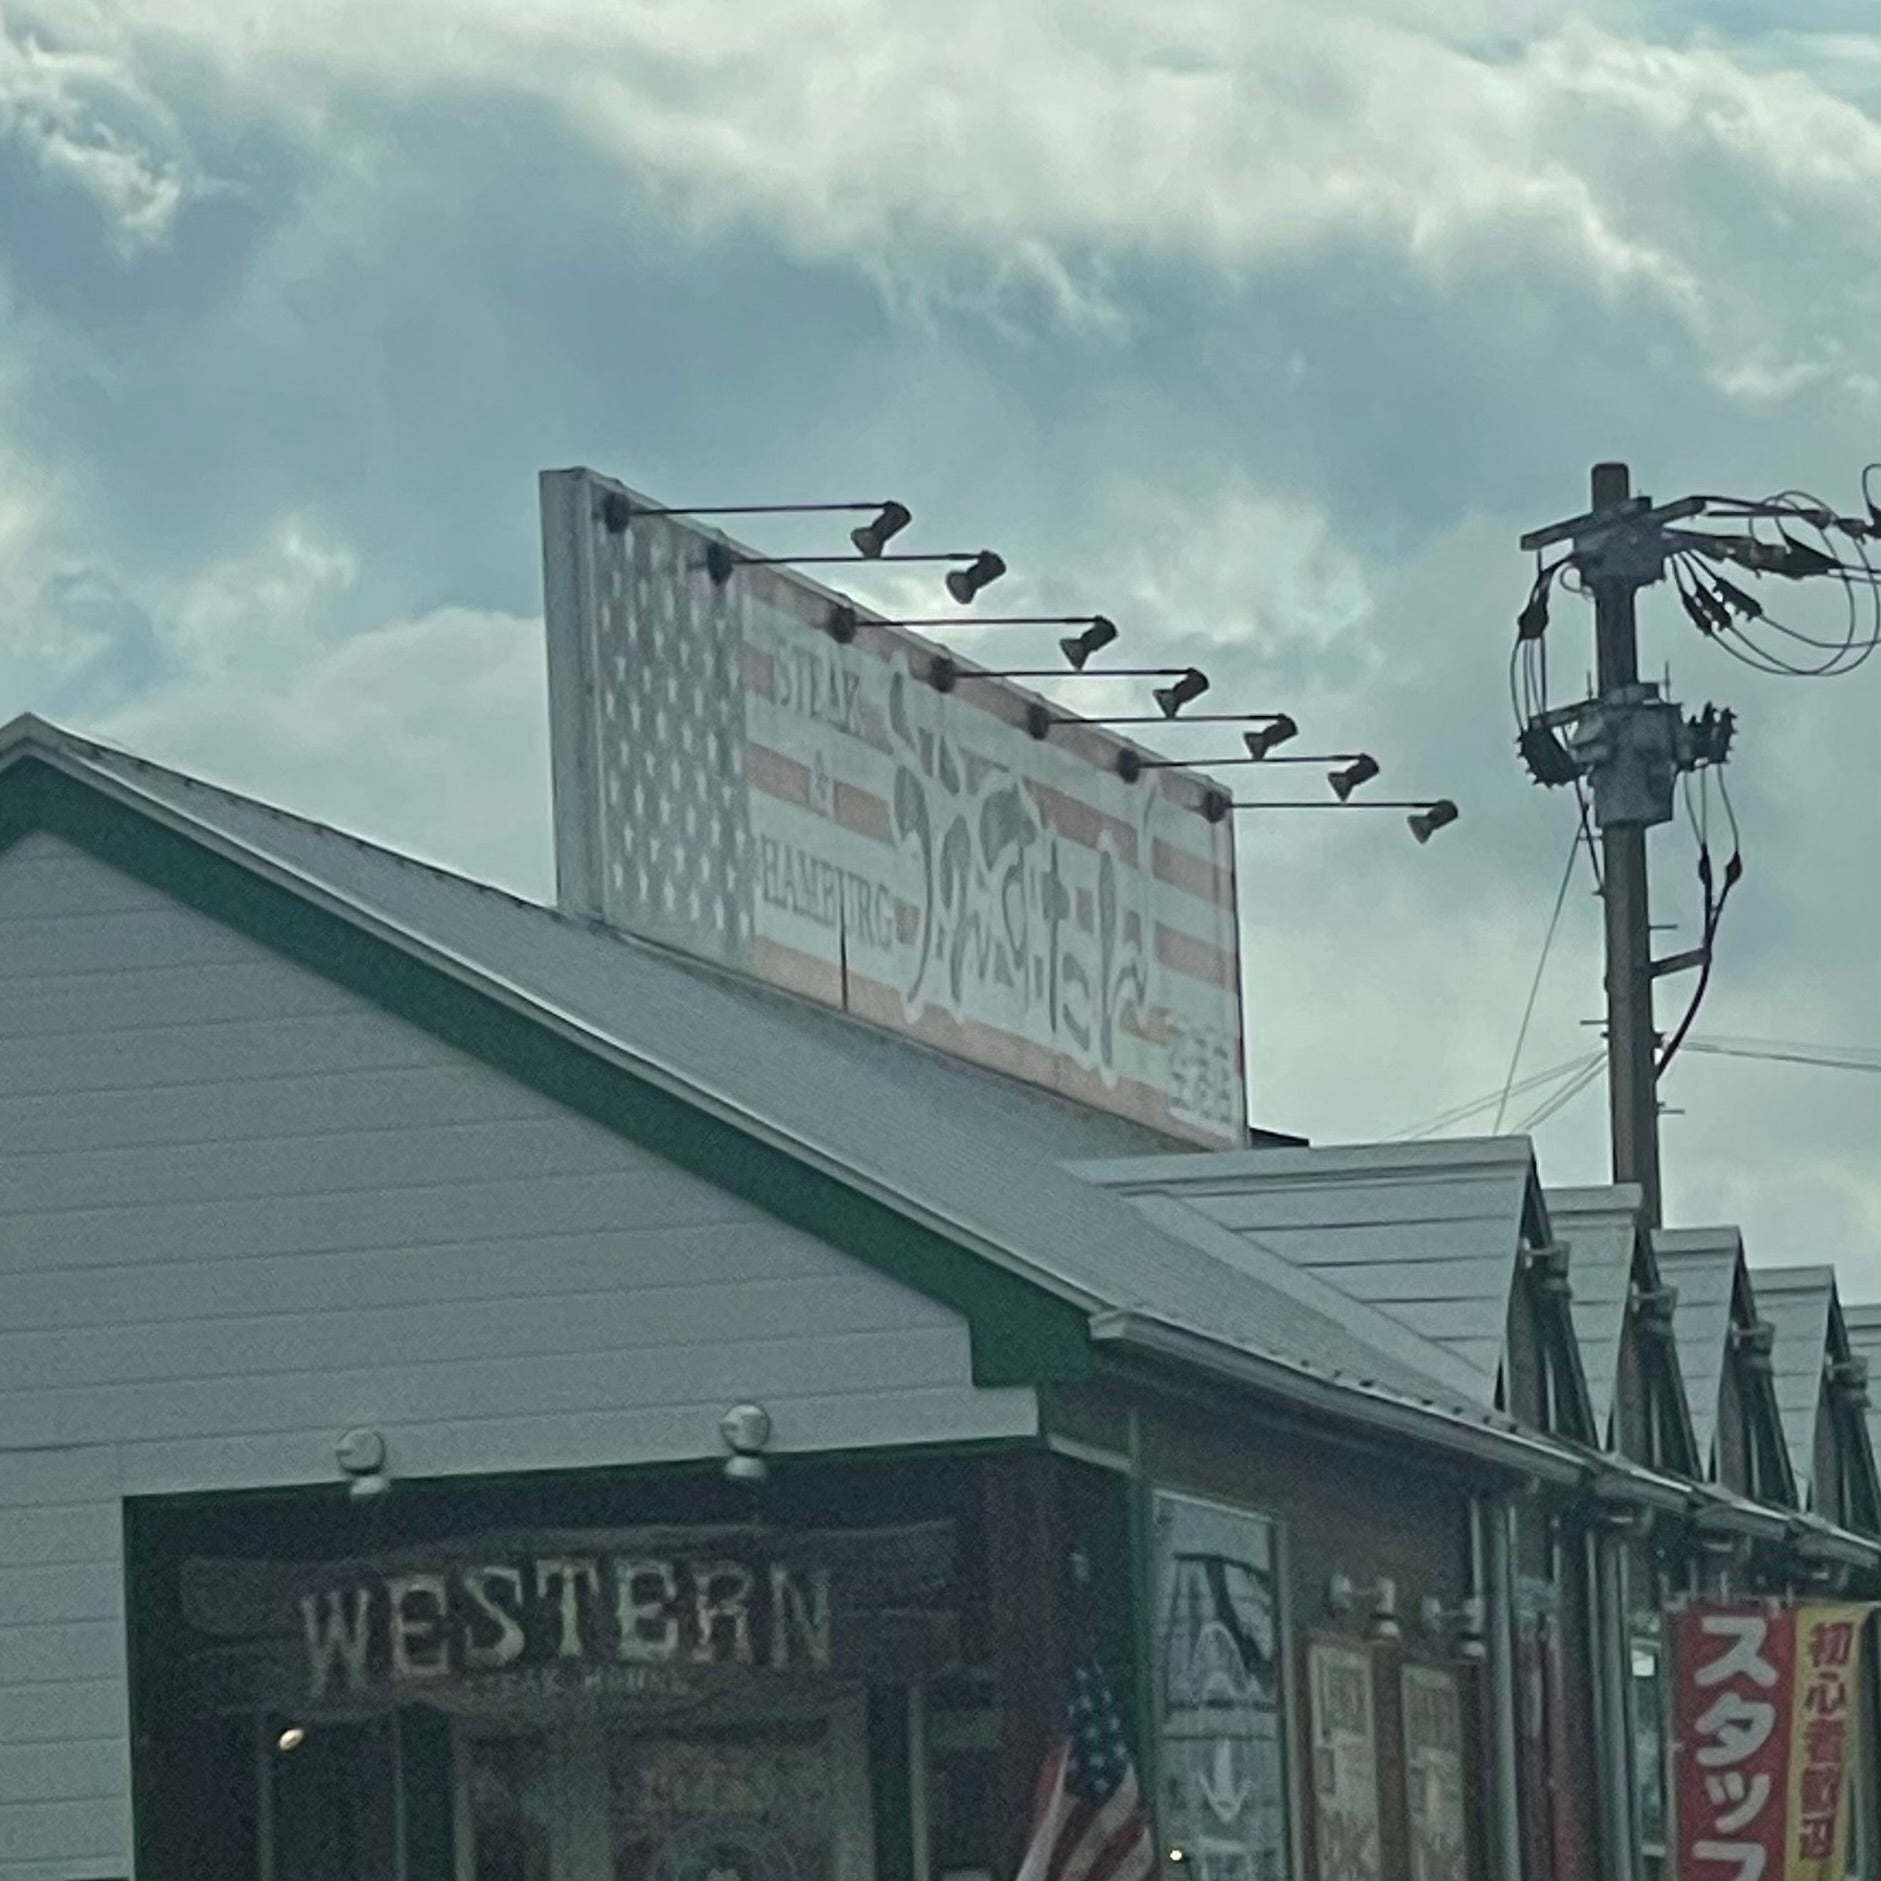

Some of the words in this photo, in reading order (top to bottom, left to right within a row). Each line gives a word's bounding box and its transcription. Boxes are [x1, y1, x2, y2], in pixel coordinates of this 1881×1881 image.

[302, 1555, 834, 1697] WESTERN
[1691, 1614, 1780, 1881] スタッフ
